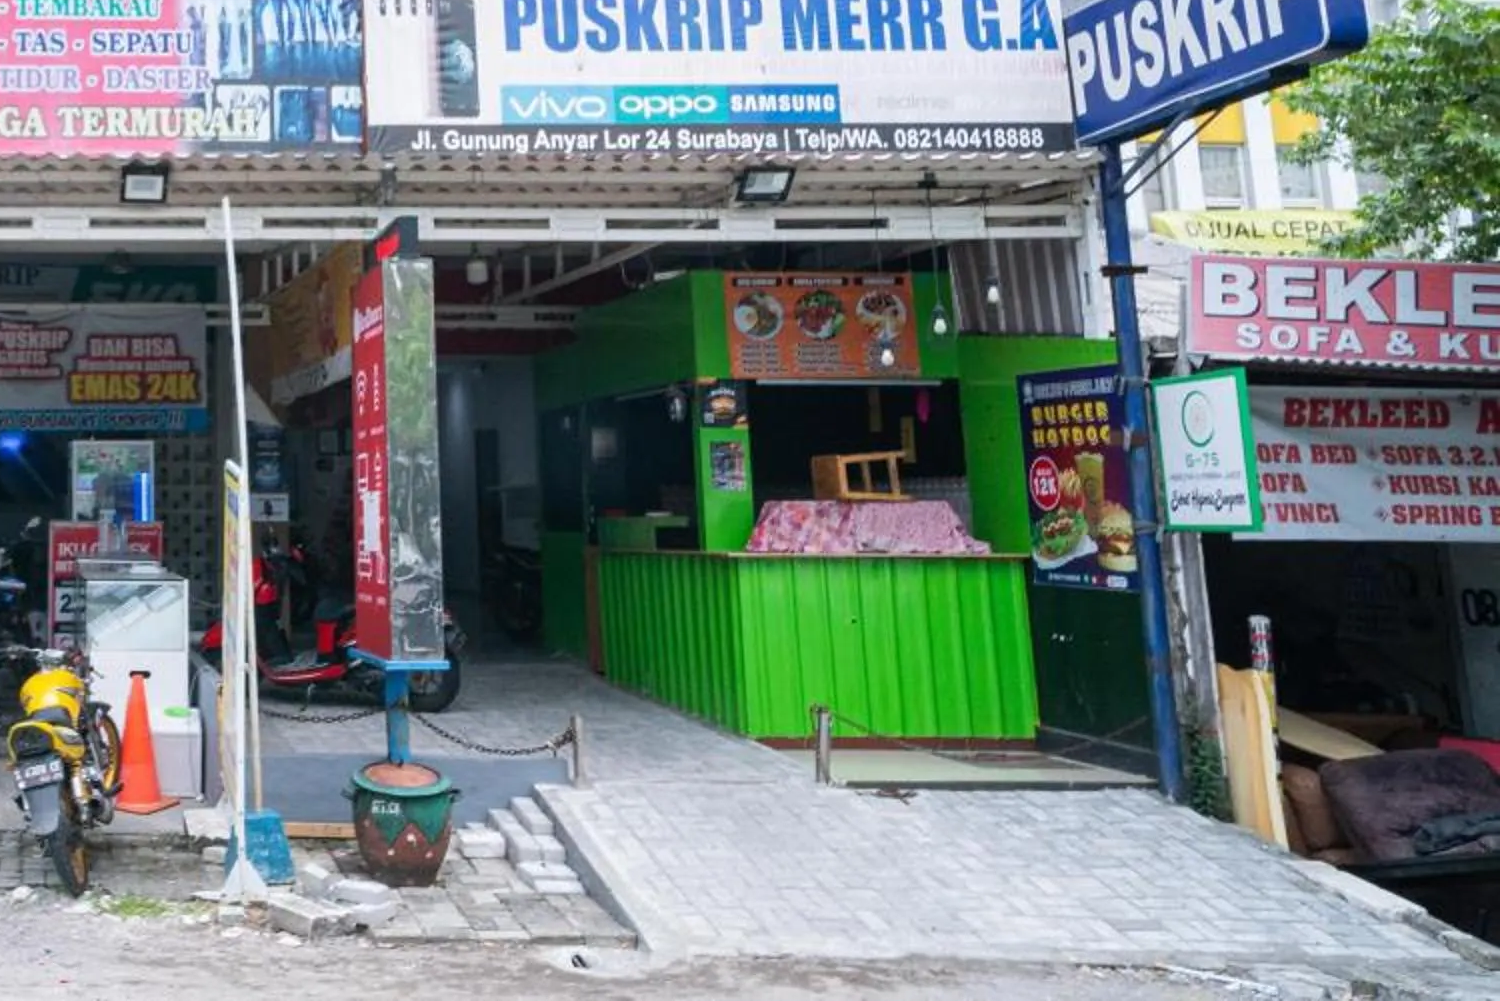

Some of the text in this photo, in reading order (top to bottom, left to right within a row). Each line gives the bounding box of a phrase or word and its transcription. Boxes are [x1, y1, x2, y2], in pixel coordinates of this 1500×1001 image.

[15, 29, 66, 56] TAS
[91, 29, 194, 57] SEPATU
[0, 65, 79, 91] TIDUR
[105, 66, 212, 91] DASTER
[510, 89, 608, 119] vivo
[618, 94, 720, 119] oppo
[730, 94, 836, 113] SAMSUNG
[55, 108, 262, 139] TERMURAH
[411, 128, 438, 149] Jl.
[443, 128, 529, 155] Gunung
[535, 129, 599, 154] Anyar
[604, 128, 640, 149] Lor
[646, 129, 671, 149] 24
[676, 128, 778, 153] Surabaya
[798, 128, 888, 153] Telp/WA.
[895, 128, 1045, 148] 082140418888
[1203, 262, 1500, 327] BEKLE
[1236, 323, 1364, 354] SOFA
[71, 374, 197, 400] EMAS 24K
[1283, 399, 1450, 428] BEKLEED
[1256, 443, 1357, 465] OFA BED
[1382, 445, 1446, 465] SOFA
[1257, 473, 1308, 494] OFA
[1389, 475, 1462, 495] KURSI
[1391, 506, 1482, 527] SPRING
